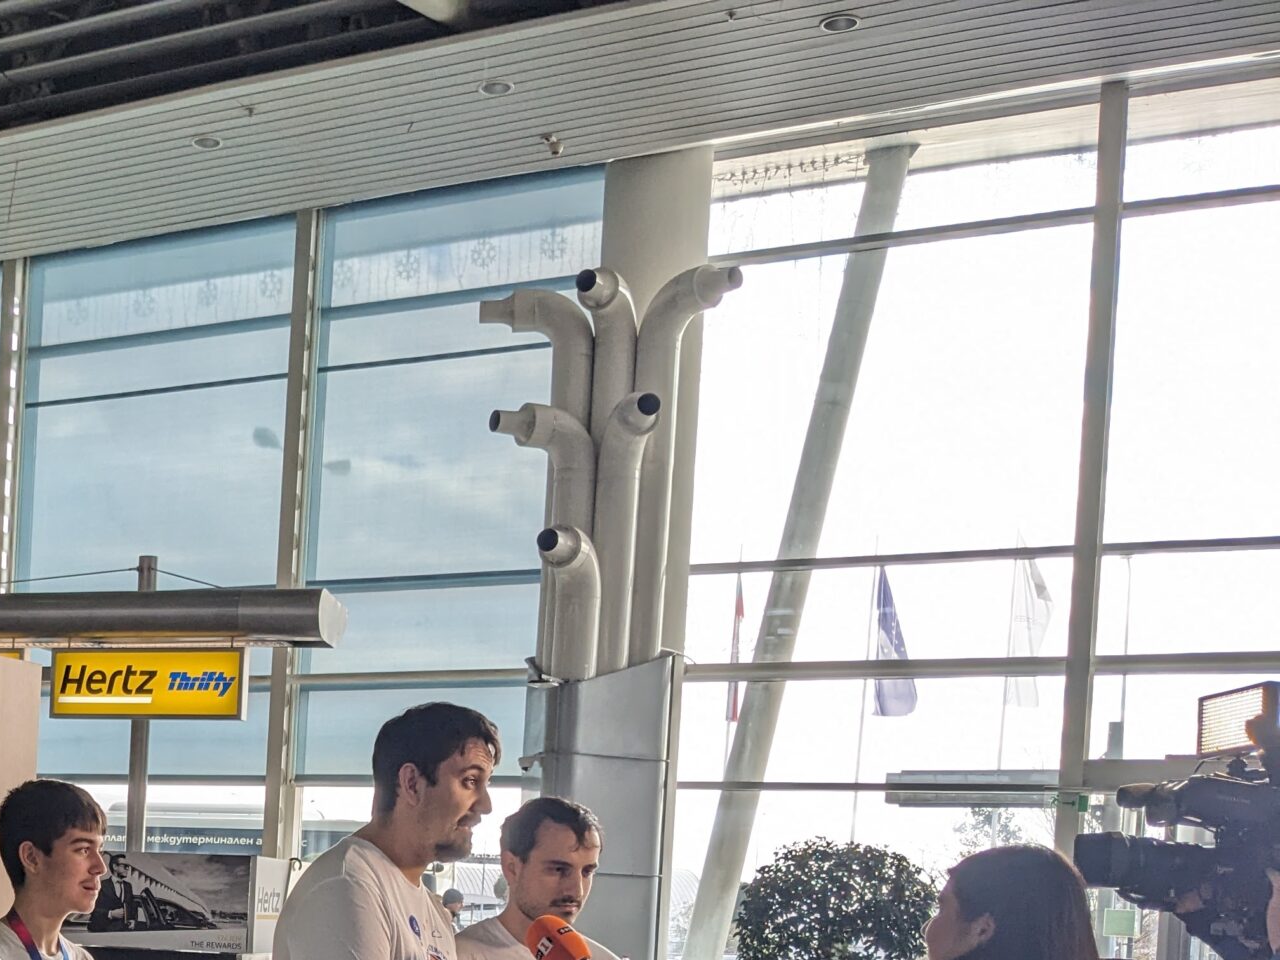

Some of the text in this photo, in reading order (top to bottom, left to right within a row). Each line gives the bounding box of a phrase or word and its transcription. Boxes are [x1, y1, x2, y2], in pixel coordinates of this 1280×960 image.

[59, 664, 237, 697] Hertz Thrifty
[256, 886, 281, 913] Hertz
[191, 940, 242, 950] THE REWARDS
